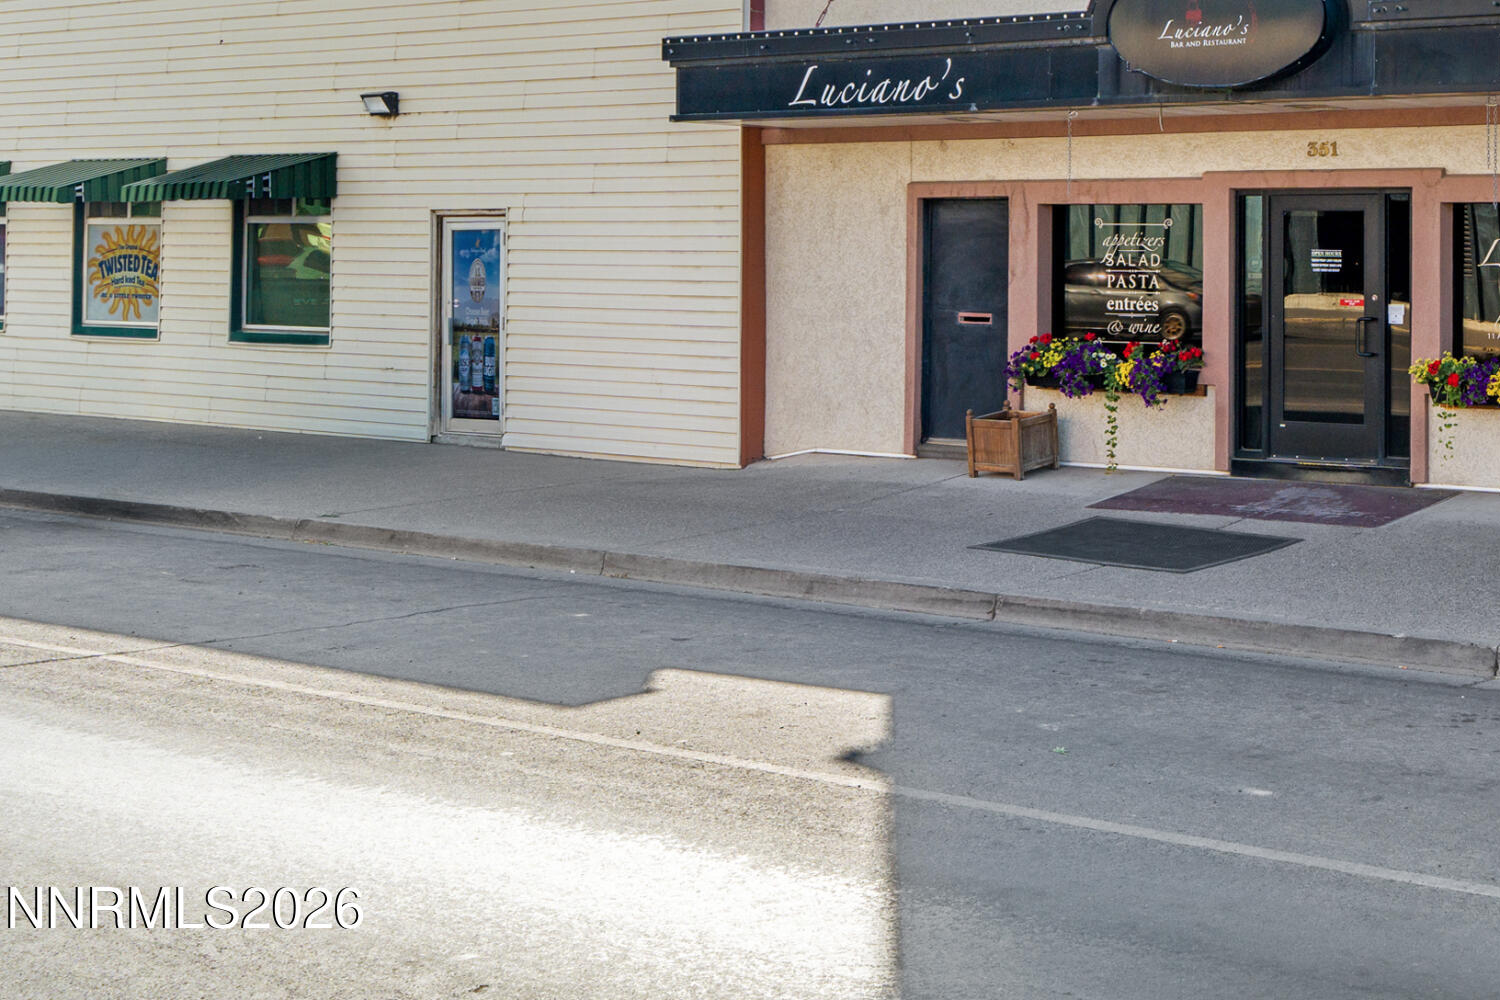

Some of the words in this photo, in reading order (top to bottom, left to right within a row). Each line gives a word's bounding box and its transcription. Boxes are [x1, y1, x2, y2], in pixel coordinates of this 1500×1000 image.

[1157, 14, 1249, 40] Luciano's
[1170, 41, 1184, 49] BAR
[1185, 40, 1201, 48] AND
[1202, 37, 1247, 47] RESTAURANT
[788, 57, 965, 107] Luciano's
[1306, 140, 1339, 157] 351
[1100, 231, 1166, 264] appetizers
[98, 253, 140, 279] TWISTED
[141, 254, 159, 281] TEA
[1105, 253, 1161, 267] SALAD
[1107, 273, 1161, 289] PASTA
[1106, 295, 1159, 311] entrées
[1128, 318, 1162, 334] wine
